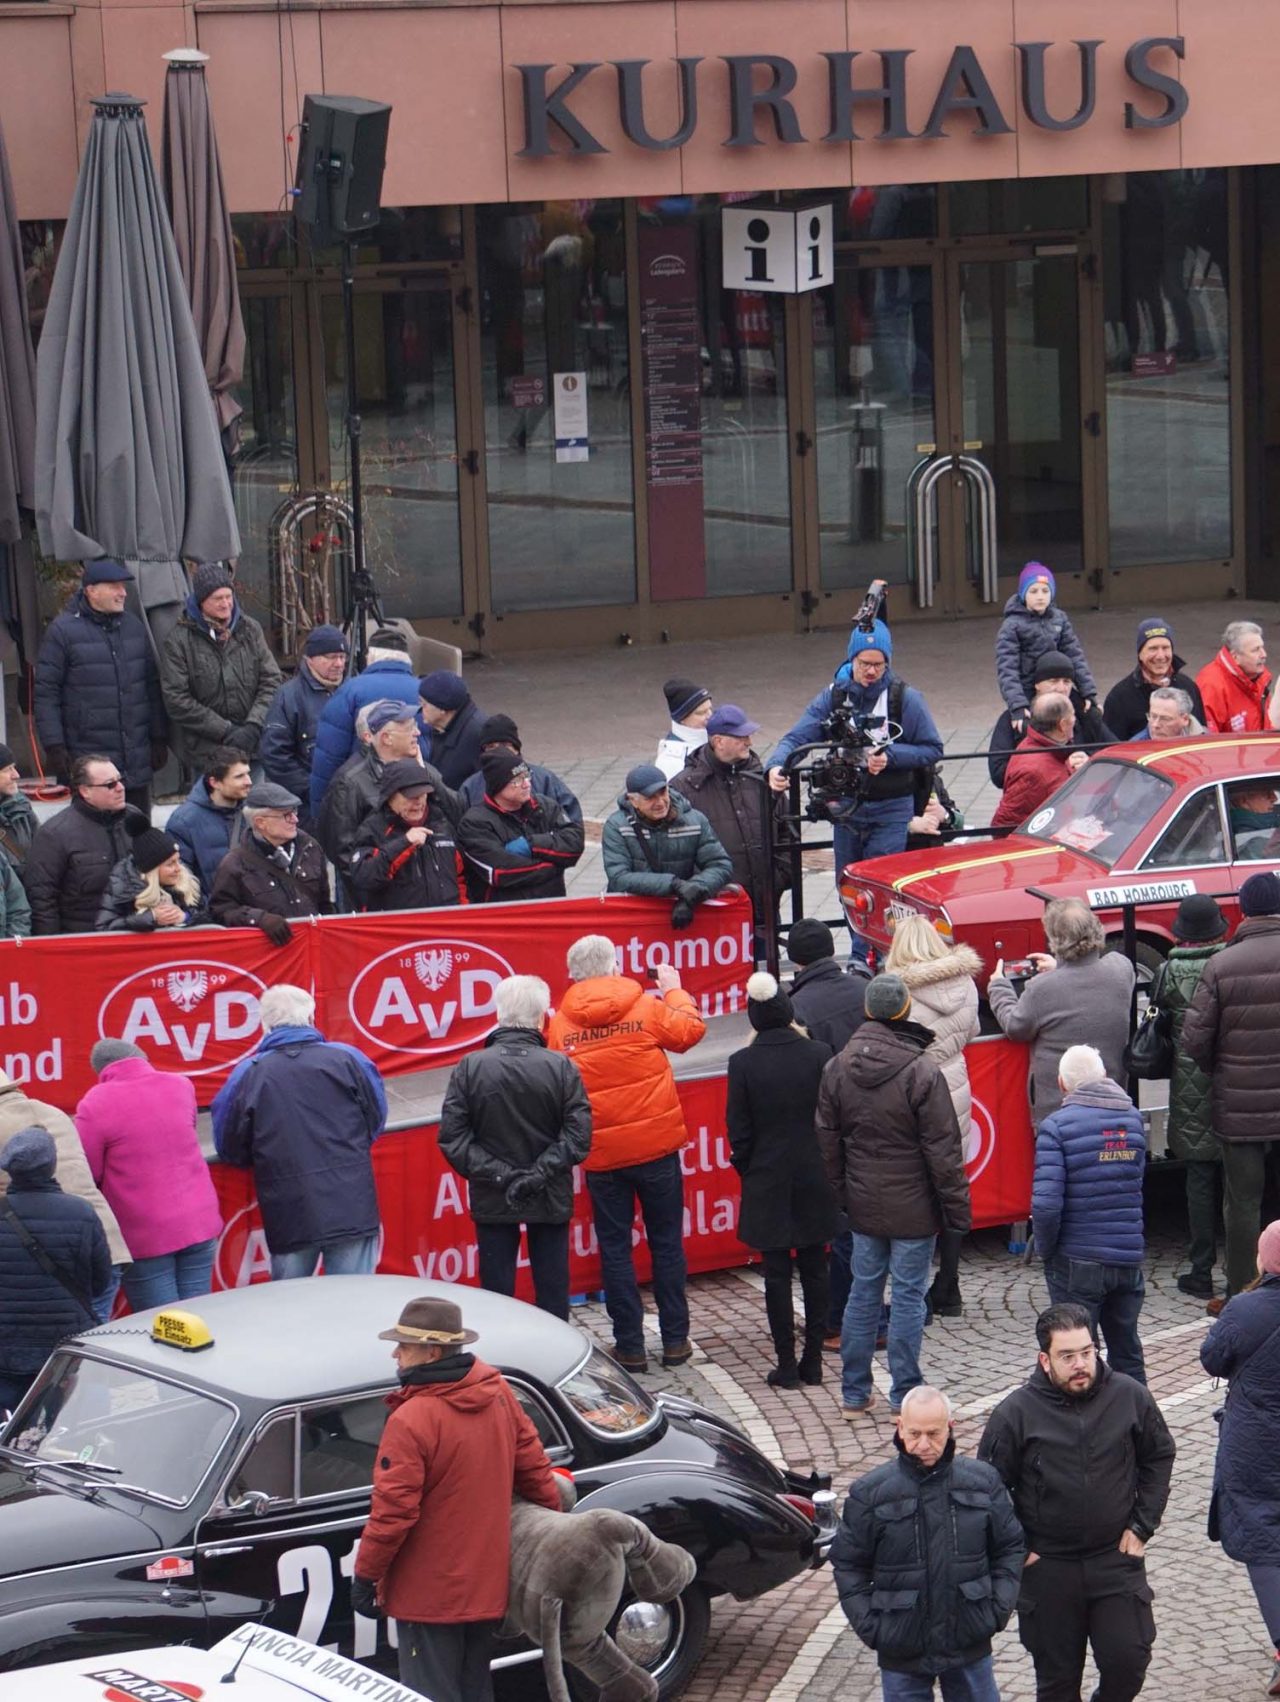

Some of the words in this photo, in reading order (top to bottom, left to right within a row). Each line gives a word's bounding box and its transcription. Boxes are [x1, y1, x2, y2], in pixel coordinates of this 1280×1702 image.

[510, 36, 1189, 157] KURHAUS
[1122, 883, 1190, 903] HOMBOURG
[400, 957, 412, 968] 18
[455, 952, 470, 963] 99
[152, 977, 164, 988] 18
[210, 974, 227, 985] 99
[369, 968, 503, 1039] AvD
[121, 991, 262, 1061] AvD
[159, 1315, 185, 1333] PRESSE
[229, 1625, 314, 1674] LANCIA
